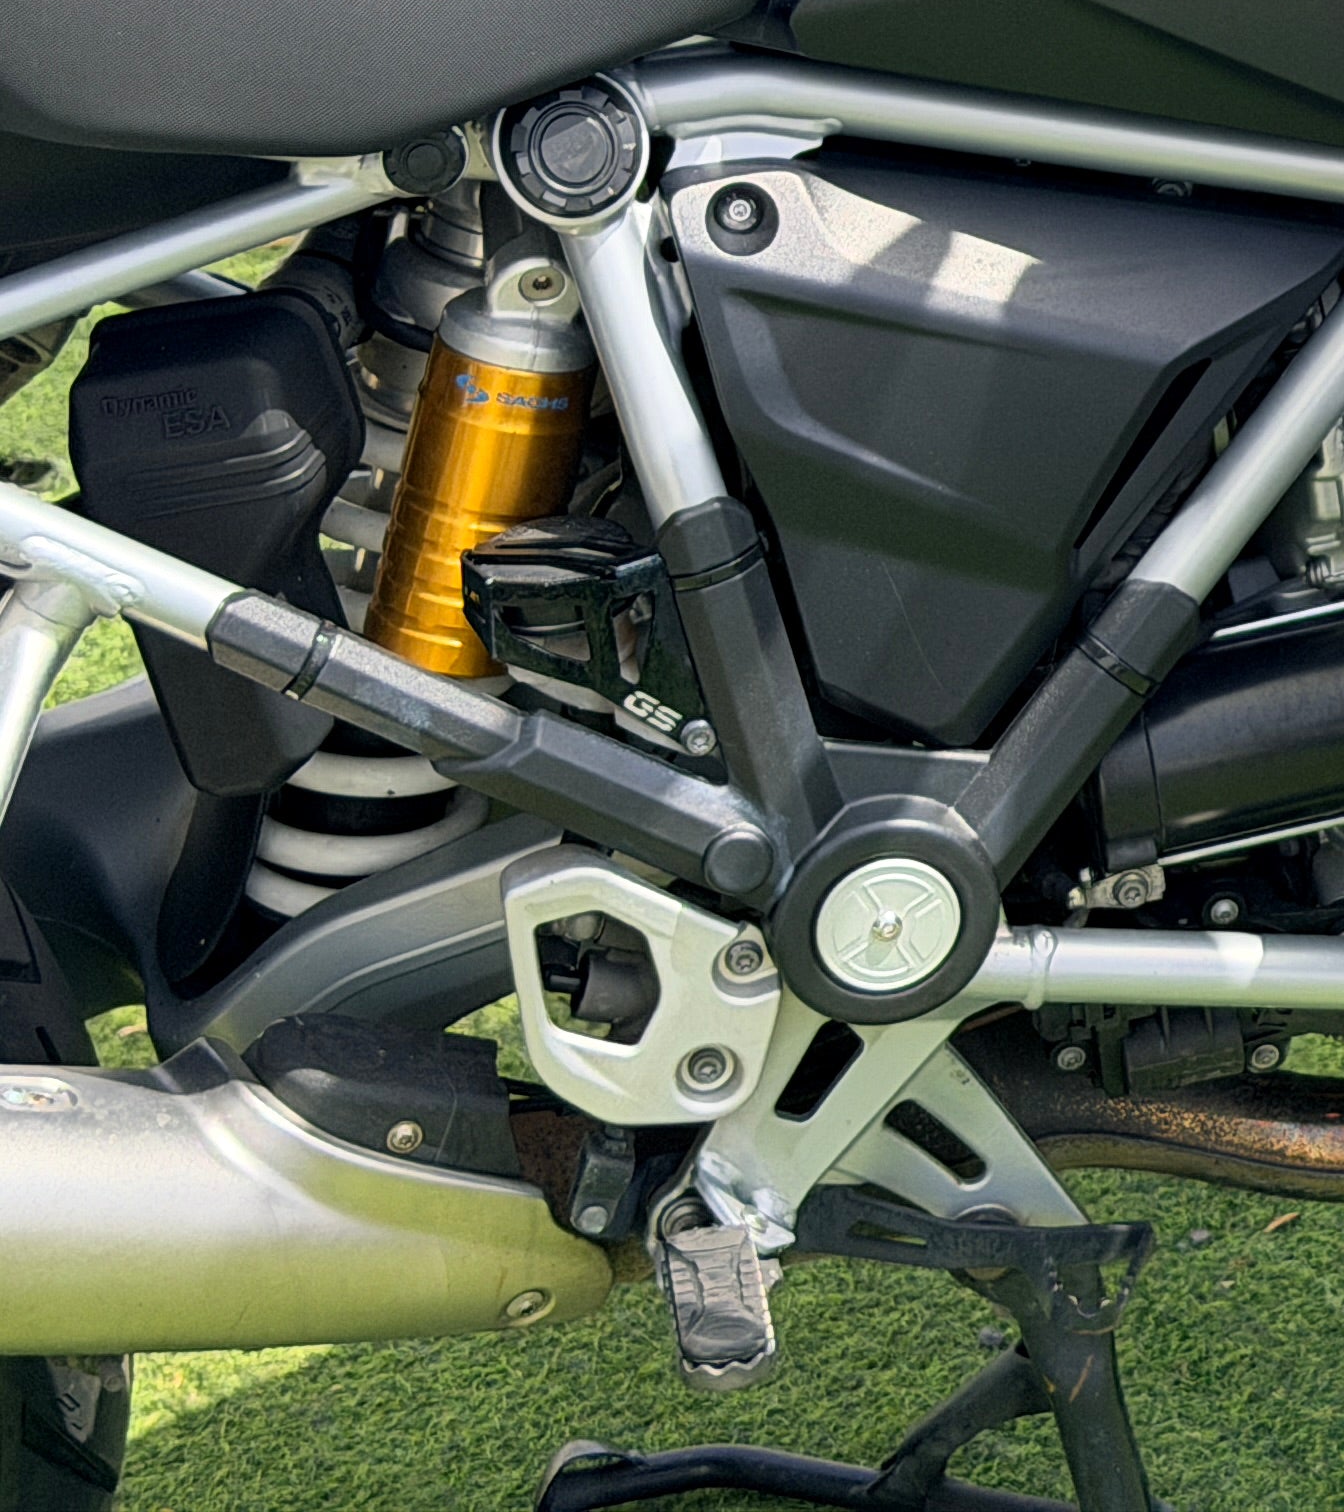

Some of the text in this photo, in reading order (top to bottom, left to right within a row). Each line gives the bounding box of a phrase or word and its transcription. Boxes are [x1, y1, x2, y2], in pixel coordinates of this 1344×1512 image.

[101, 385, 198, 418] Dynamic
[496, 392, 569, 411] SACHS
[161, 406, 231, 438] ESA
[623, 690, 683, 732] GS
